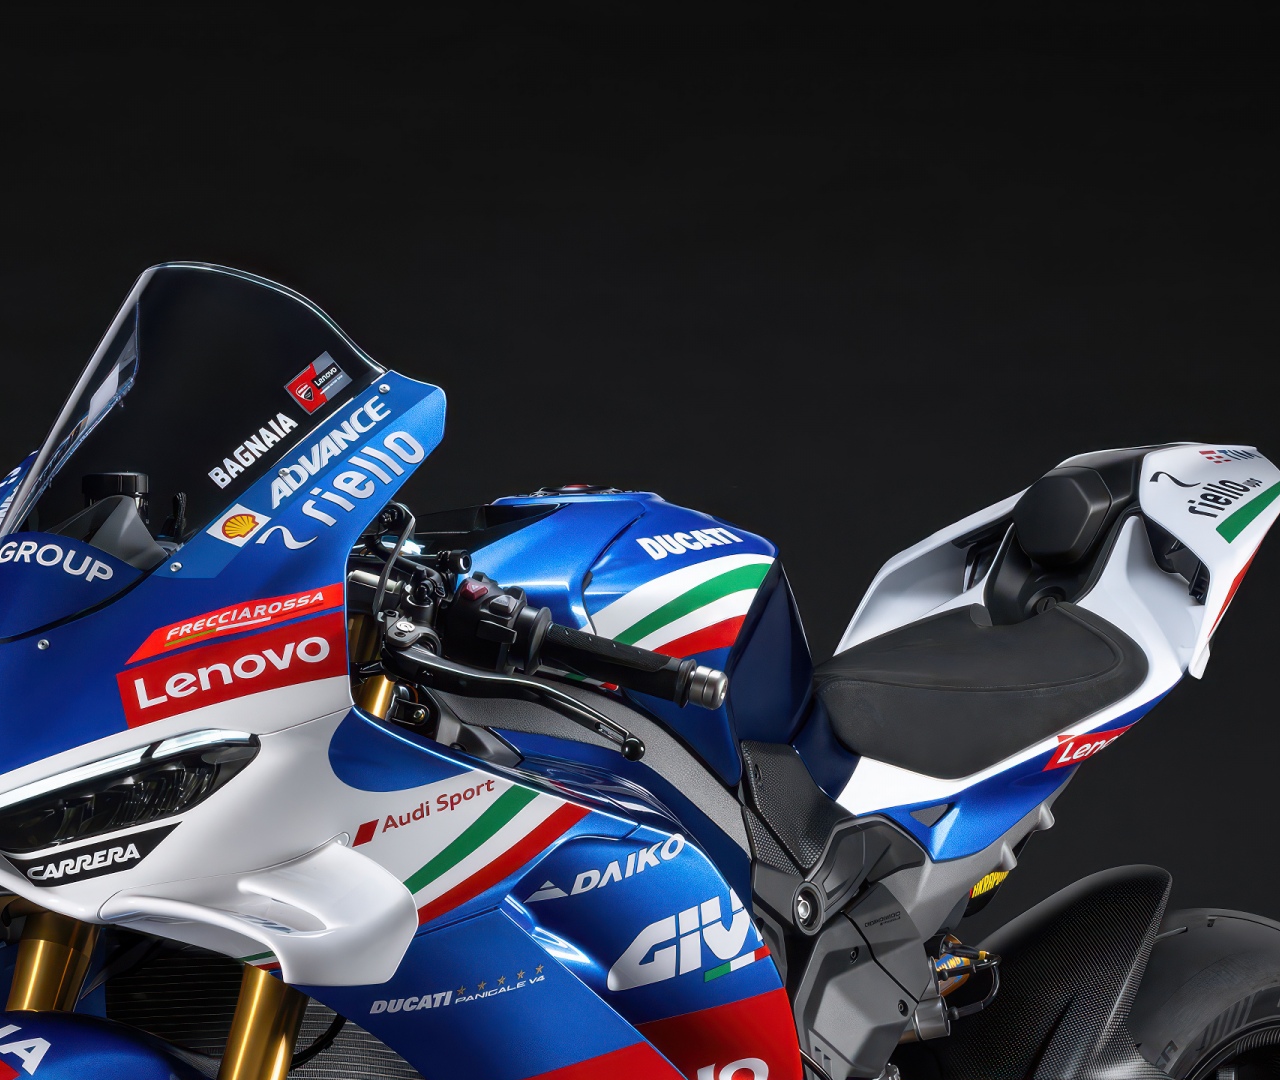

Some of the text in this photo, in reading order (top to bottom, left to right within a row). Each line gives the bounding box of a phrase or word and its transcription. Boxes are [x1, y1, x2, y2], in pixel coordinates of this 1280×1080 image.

[314, 367, 338, 387] Lenovo
[208, 412, 299, 489] BAGNAIA
[271, 395, 392, 510] ADVANCE
[301, 431, 425, 528] riello
[1187, 479, 1251, 519] riello
[635, 527, 744, 561] DUCATI
[166, 591, 324, 641] FRECCIAROSSA
[134, 636, 331, 710] Lenovo
[1056, 735, 1119, 764] Len
[382, 779, 496, 833] Audi Sport
[26, 843, 141, 881] CARRERA
[570, 833, 686, 896] DAIKO
[606, 888, 764, 992] GIV
[369, 974, 546, 1014] DUCATI PANIGALE V4
